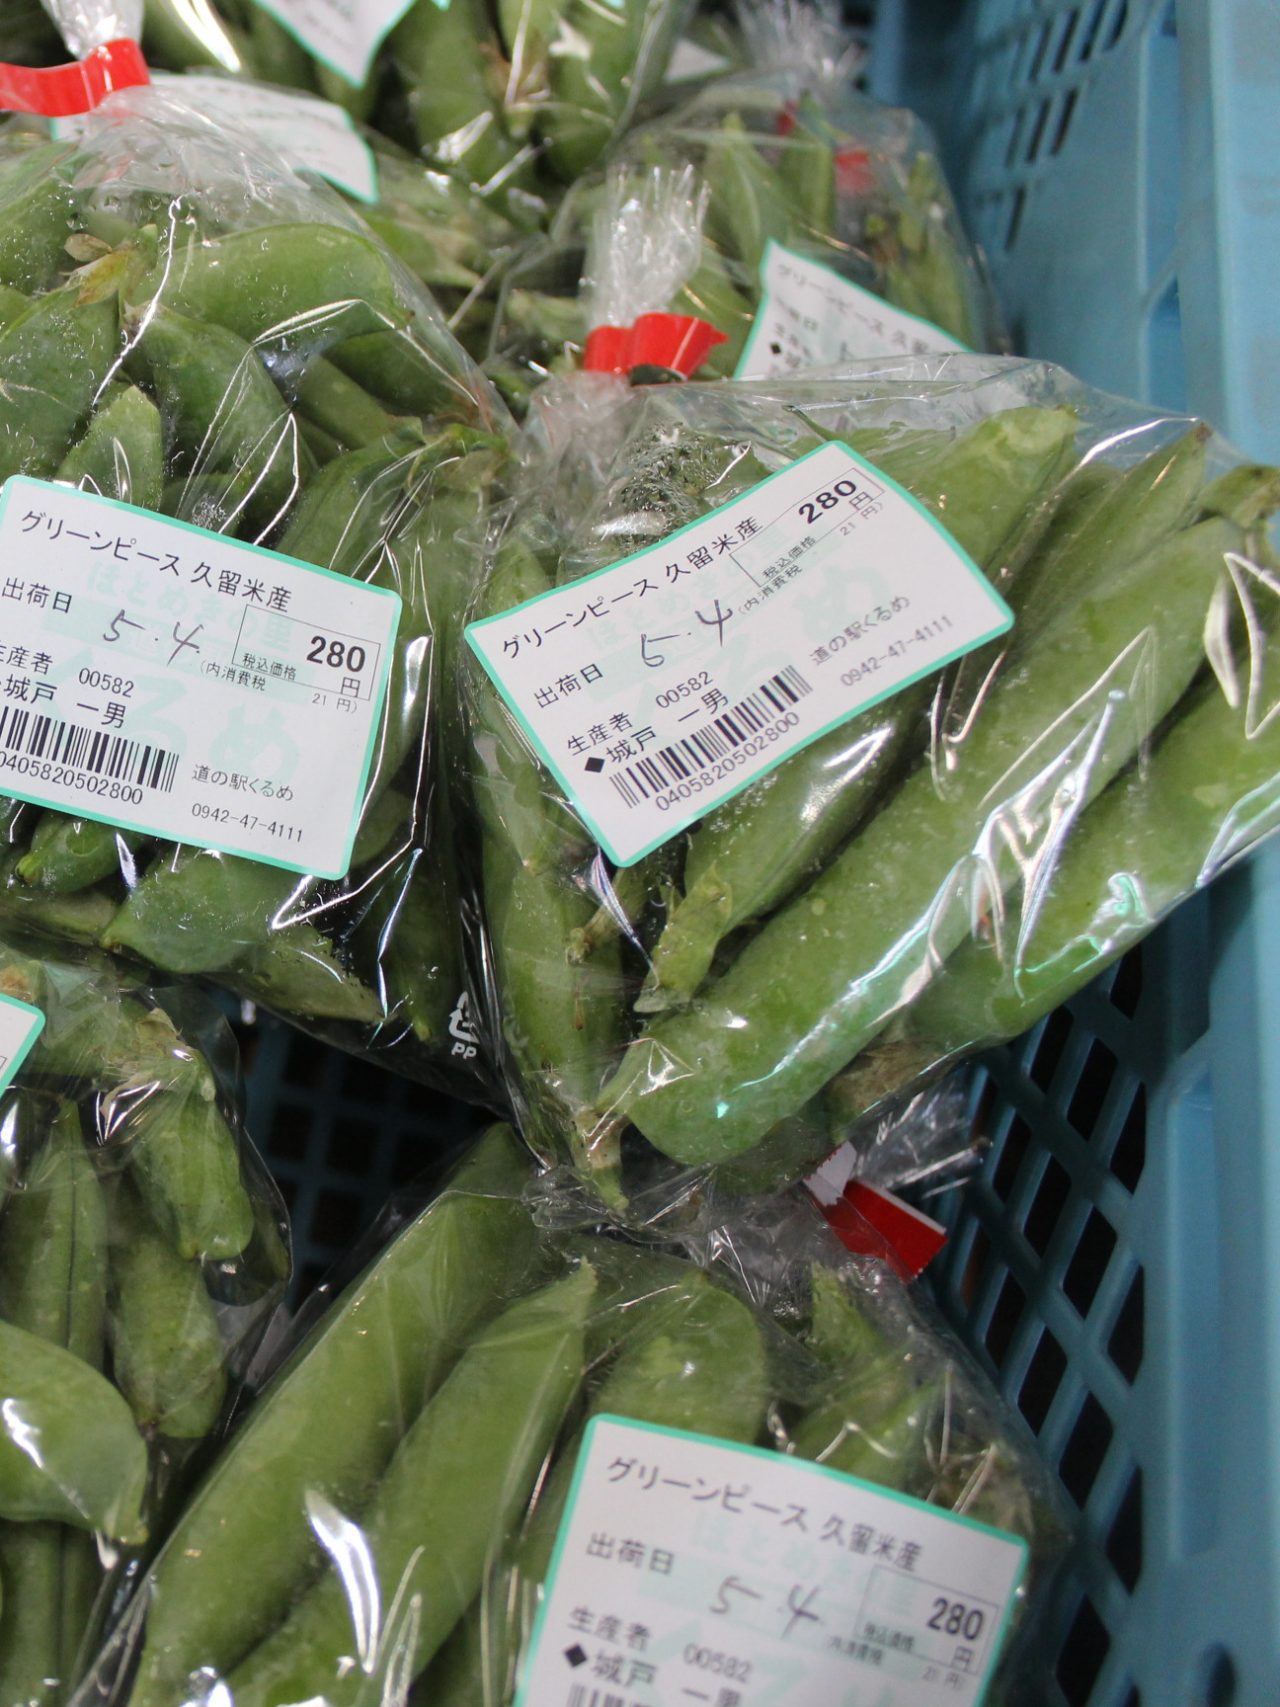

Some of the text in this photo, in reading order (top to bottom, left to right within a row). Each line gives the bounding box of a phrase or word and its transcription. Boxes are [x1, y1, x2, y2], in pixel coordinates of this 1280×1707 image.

[763, 478, 858, 580] 税込価格 280
[21, 510, 292, 612] グリーンピース 久留米産
[1, 578, 72, 613] 出荷日
[502, 516, 763, 660] グリーンピース 久留米産
[809, 593, 911, 667] 道の駅くるめ
[840, 614, 954, 687] 0942-47-4111
[242, 636, 366, 681] 税込価格 280
[78, 668, 135, 698] 00582
[534, 662, 604, 710] 出荷日
[566, 670, 714, 756] 生産者 00582
[192, 764, 294, 801] 道の駅くるめ
[656, 711, 801, 812] 0405820502800
[191, 803, 304, 842] 0942-47-4111
[451, 1042, 477, 1059] PP
[607, 1457, 924, 1573] グリーンピース 久留米産
[586, 1531, 675, 1575] 出荷日
[925, 1597, 985, 1642] 280
[683, 1642, 754, 1684] 00582
